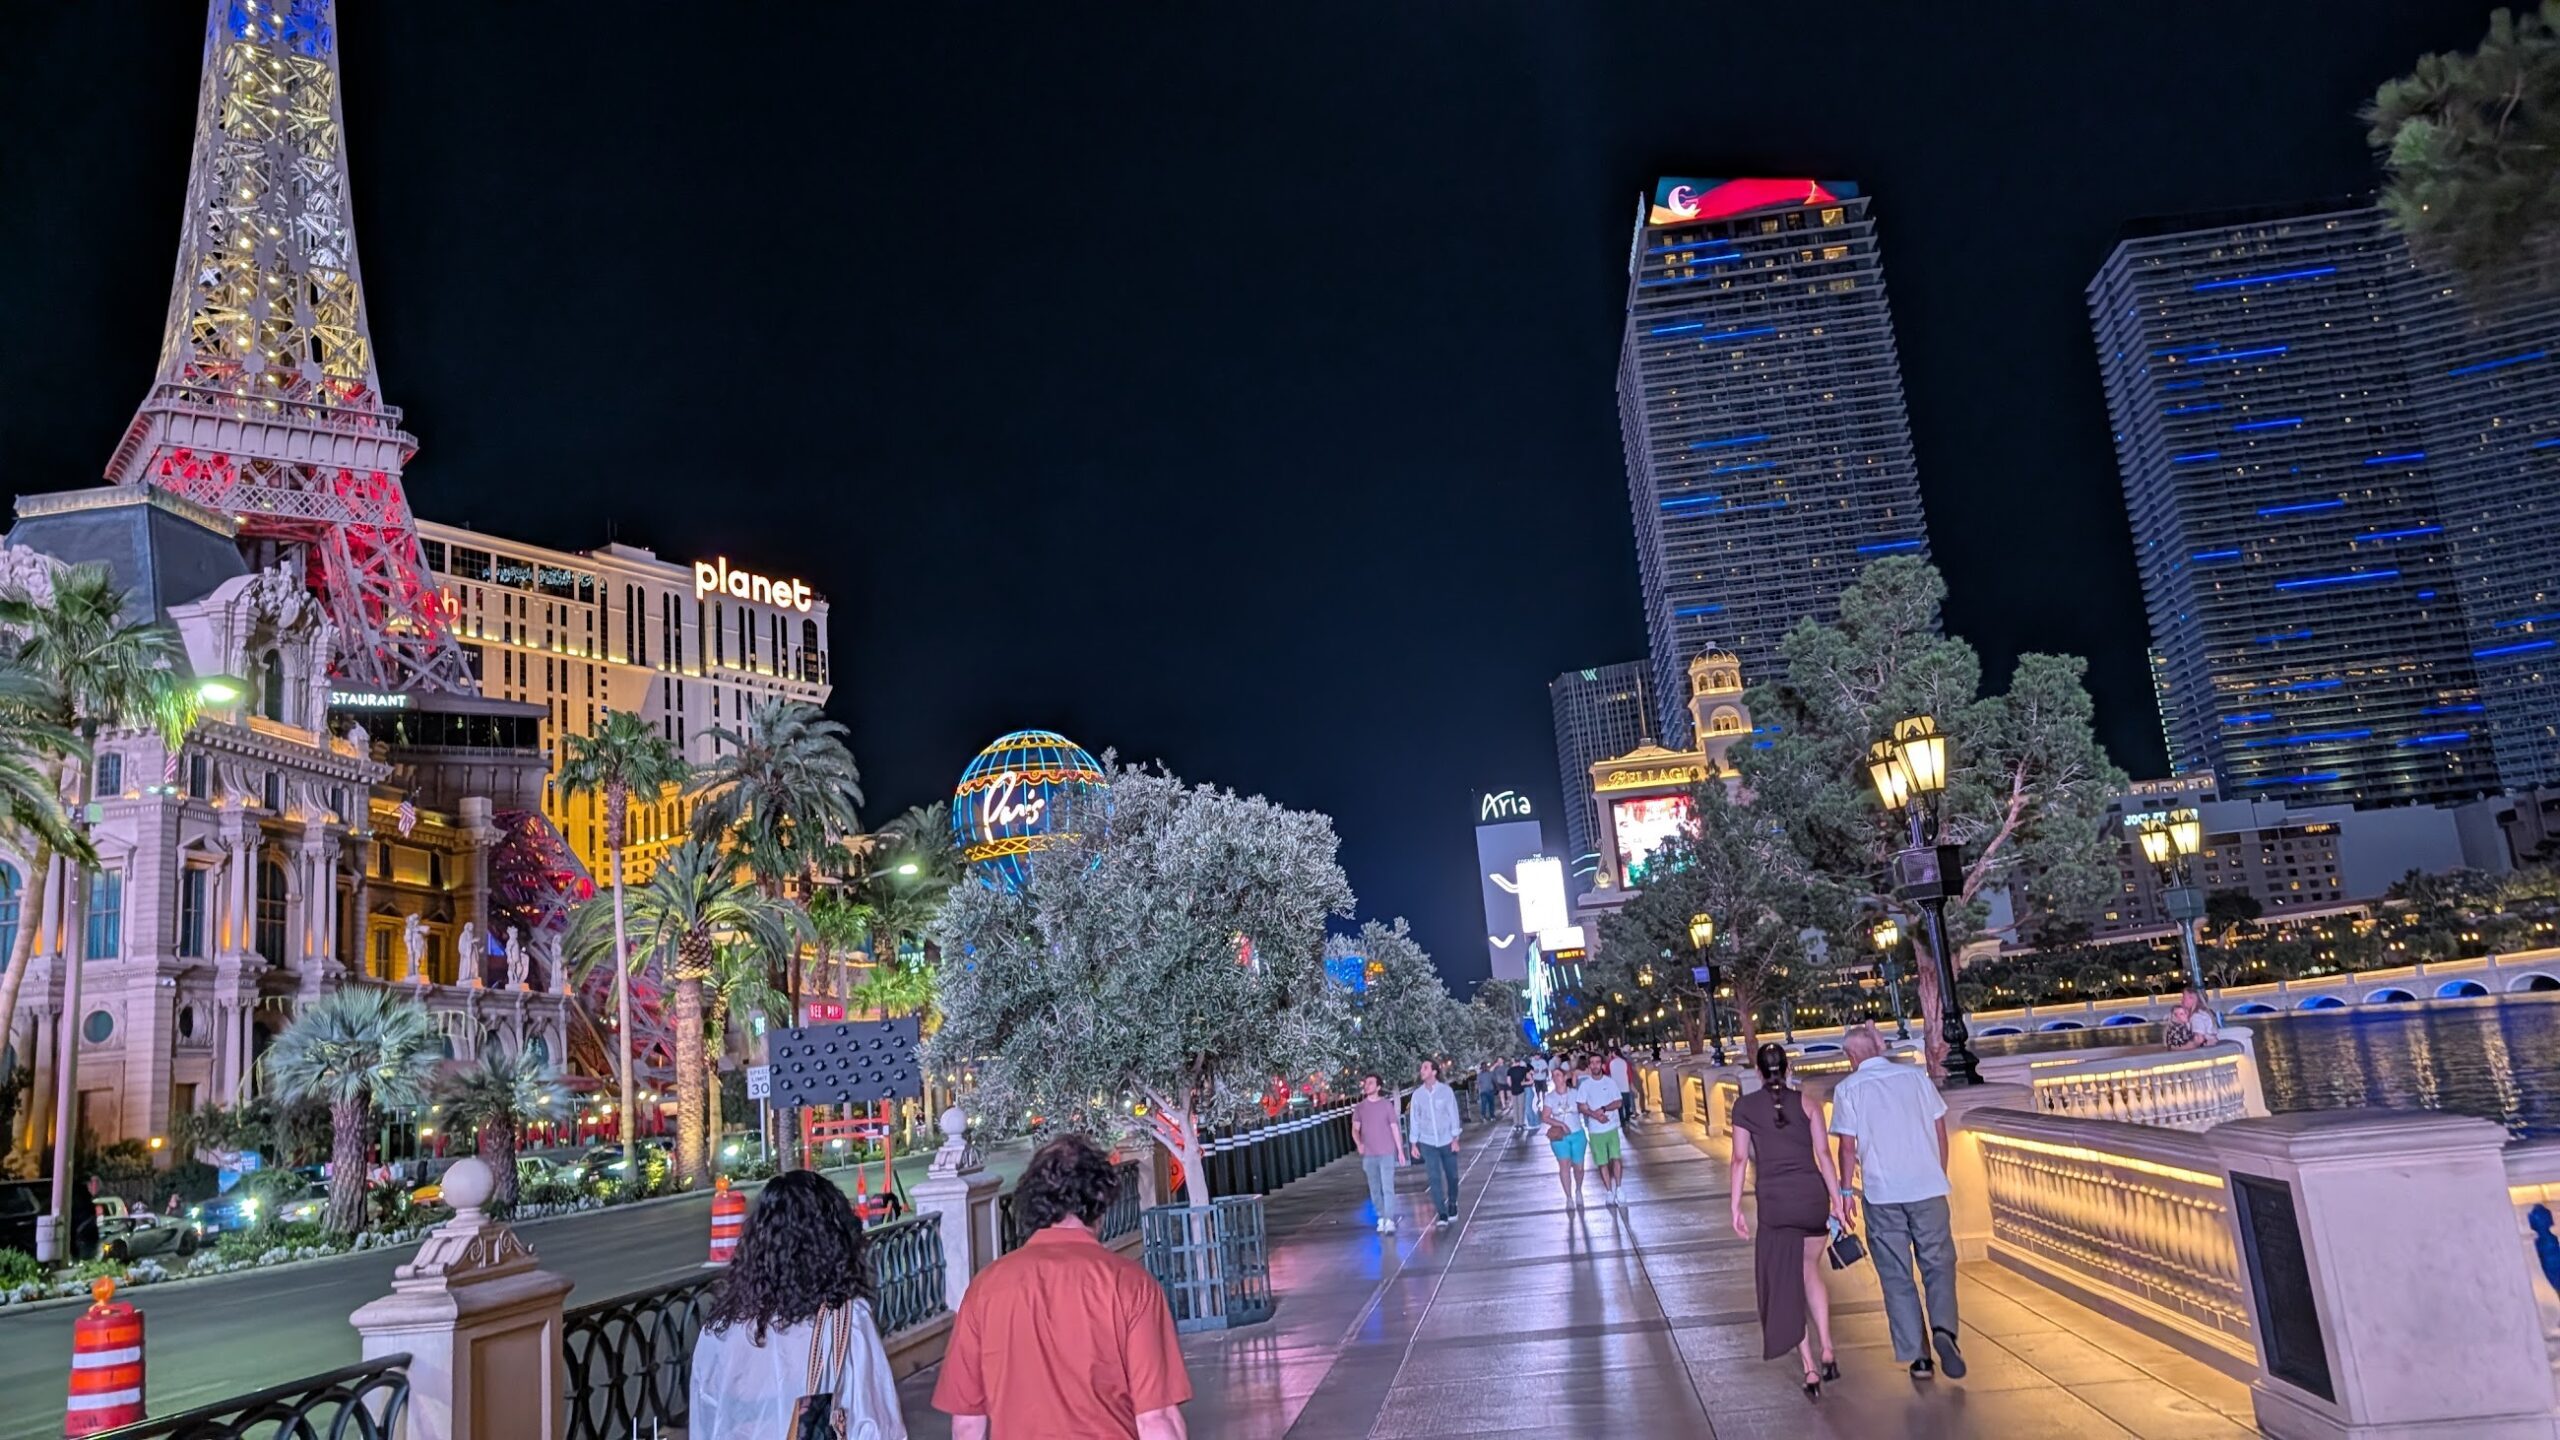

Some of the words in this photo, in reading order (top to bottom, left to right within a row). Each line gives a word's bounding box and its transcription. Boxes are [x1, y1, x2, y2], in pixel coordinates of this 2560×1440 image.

[695, 556, 812, 612] planet
[329, 691, 407, 708] STAURANT
[1608, 766, 1703, 785] BELLAGIO
[983, 770, 1045, 846] Paris
[1482, 790, 1532, 821] Aria
[751, 1082, 770, 1096] 30
